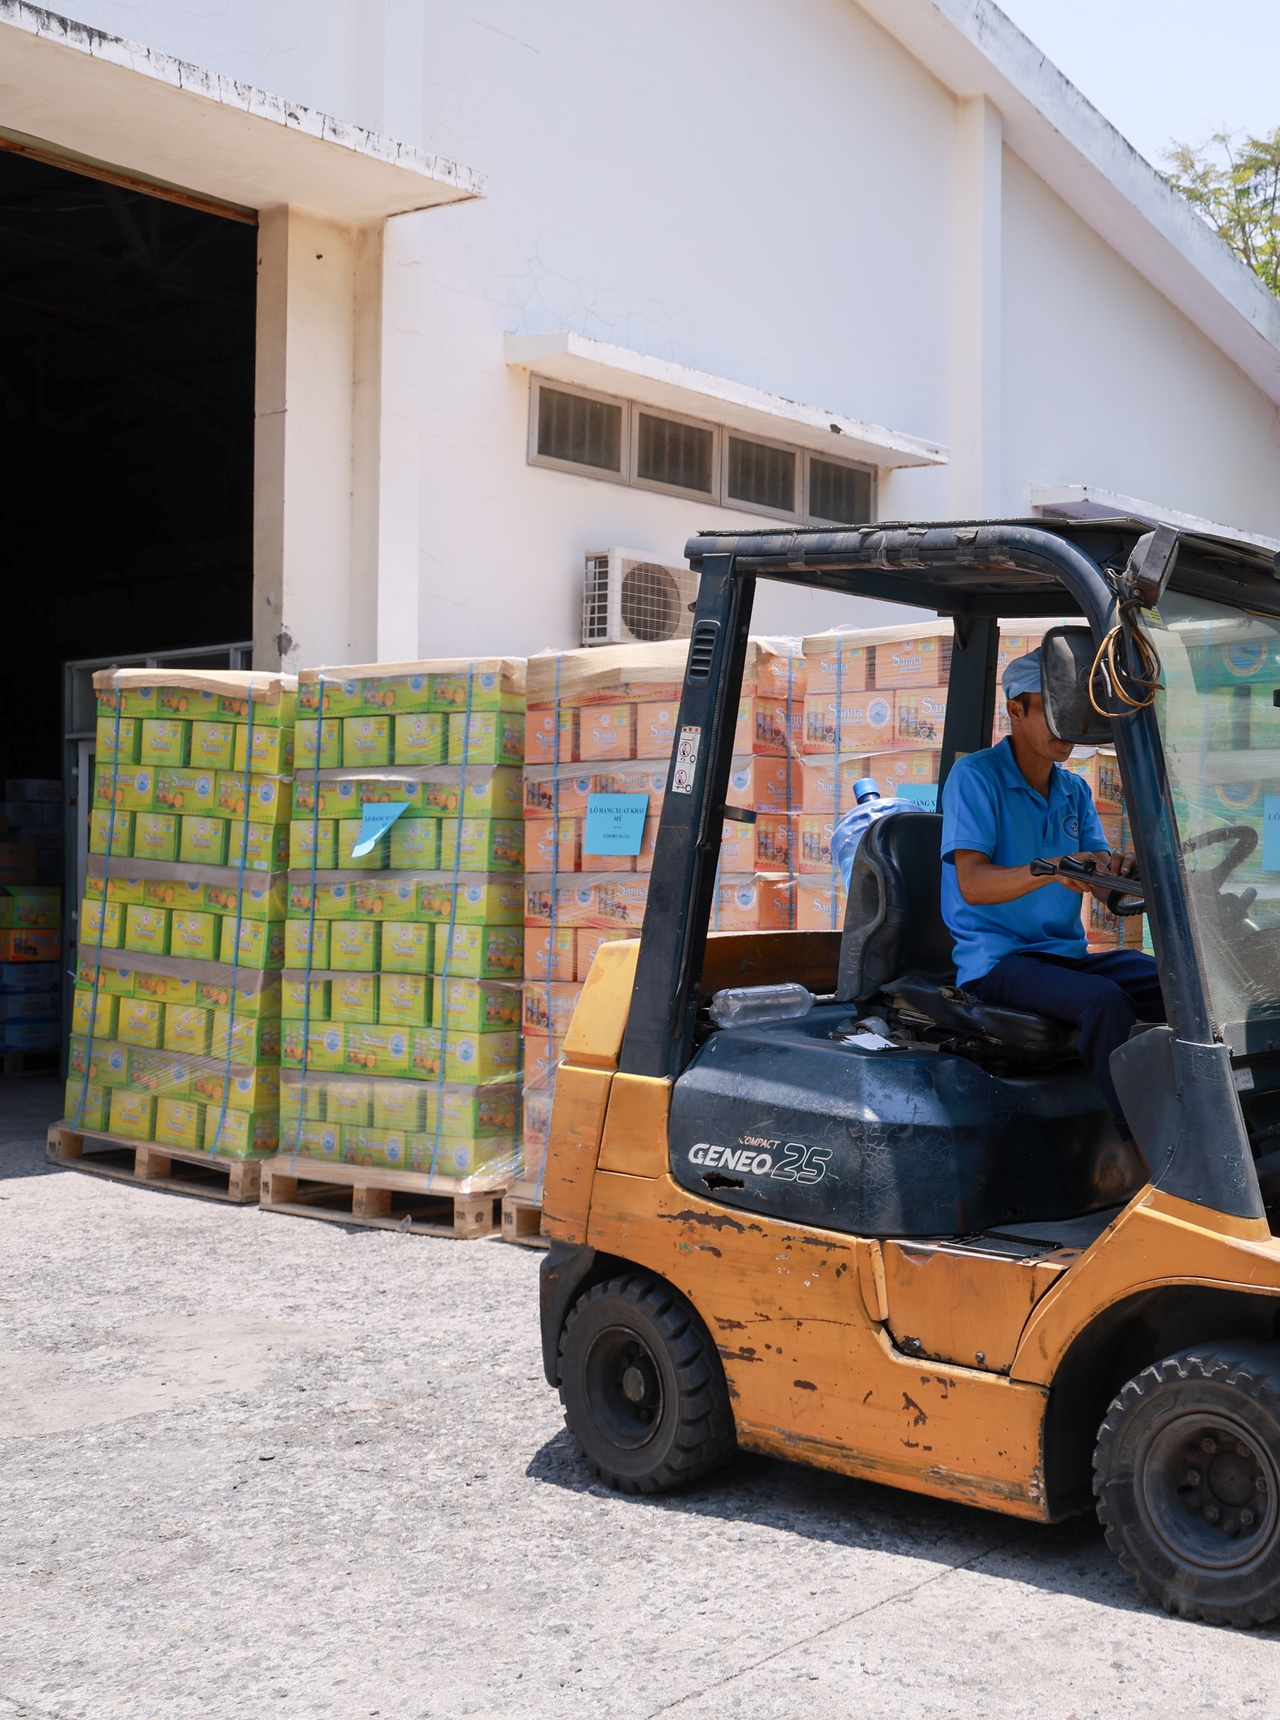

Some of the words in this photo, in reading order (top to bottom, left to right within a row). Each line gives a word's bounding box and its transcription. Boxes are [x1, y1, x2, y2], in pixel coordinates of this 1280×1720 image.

[892, 652, 922, 666] Sanna
[921, 697, 946, 714] San
[592, 728, 616, 741] Sanna
[739, 1135, 781, 1149] COMPACT
[688, 1143, 772, 1175] GENEO
[770, 1142, 833, 1185] 25
